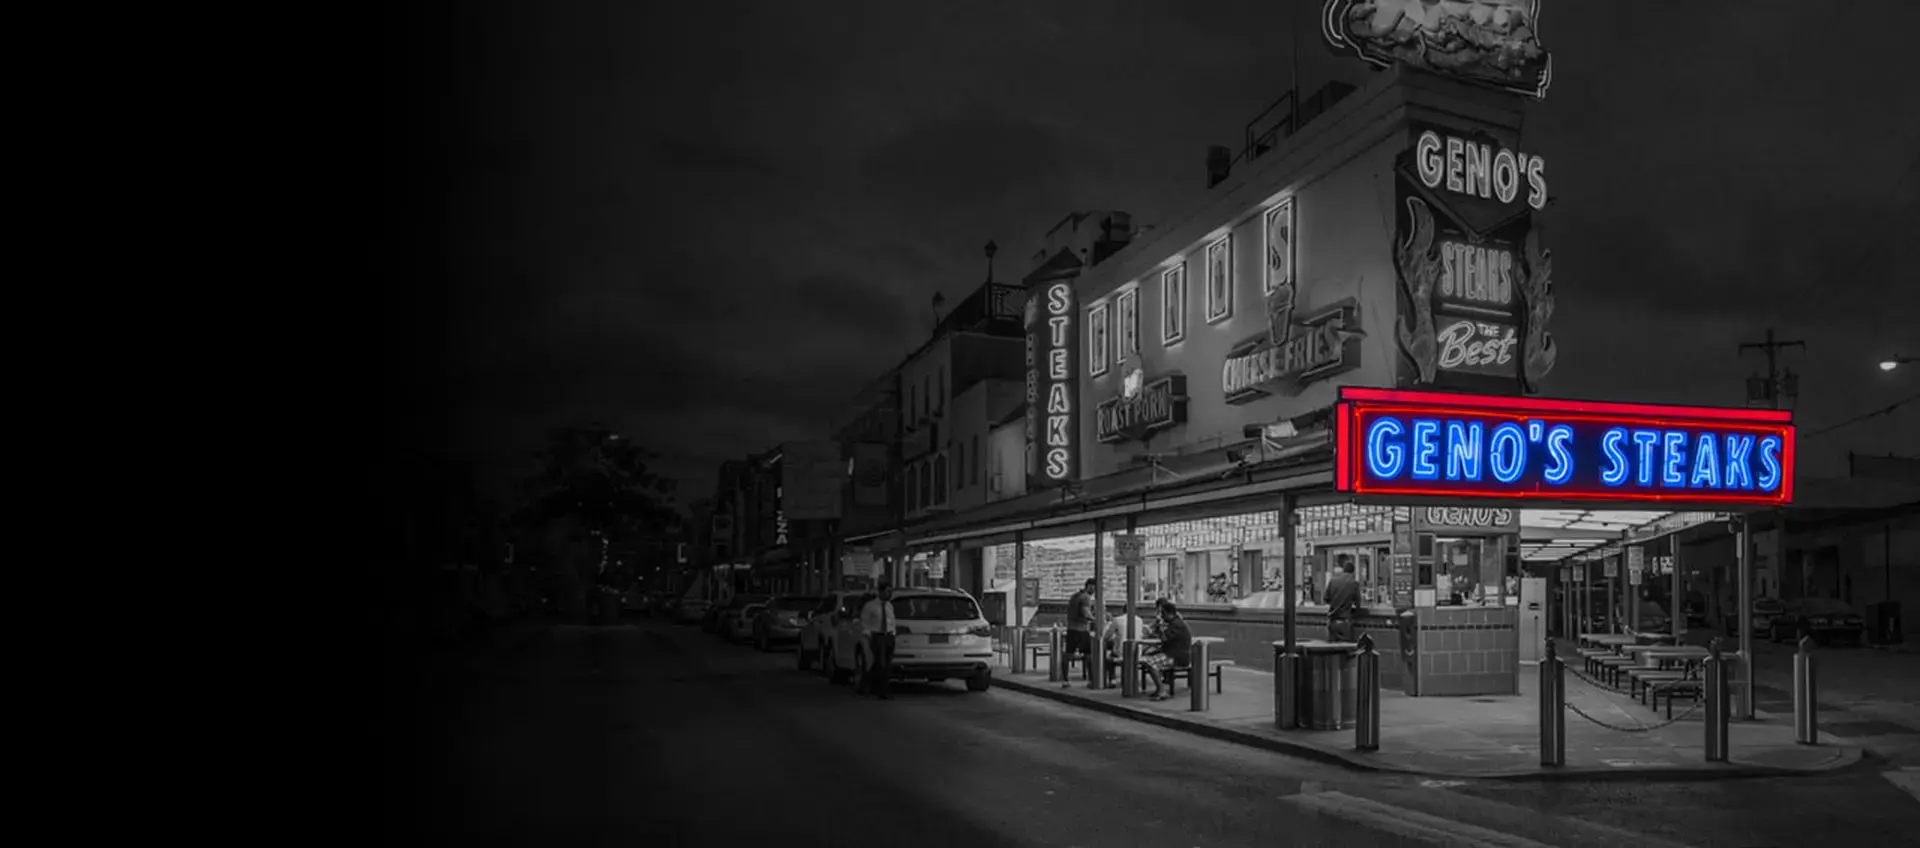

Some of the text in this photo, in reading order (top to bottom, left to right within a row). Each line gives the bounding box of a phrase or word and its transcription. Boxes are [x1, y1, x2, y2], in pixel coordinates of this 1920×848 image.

[1416, 130, 1548, 211] GENO'S
[1442, 240, 1513, 305] STEAKS
[1438, 320, 1517, 369] Best
[1477, 323, 1500, 337] THE
[1046, 284, 1071, 479] STEAKS
[1097, 386, 1168, 434] ROAST PORK
[1367, 416, 1783, 492] GENO'S STEAKS
